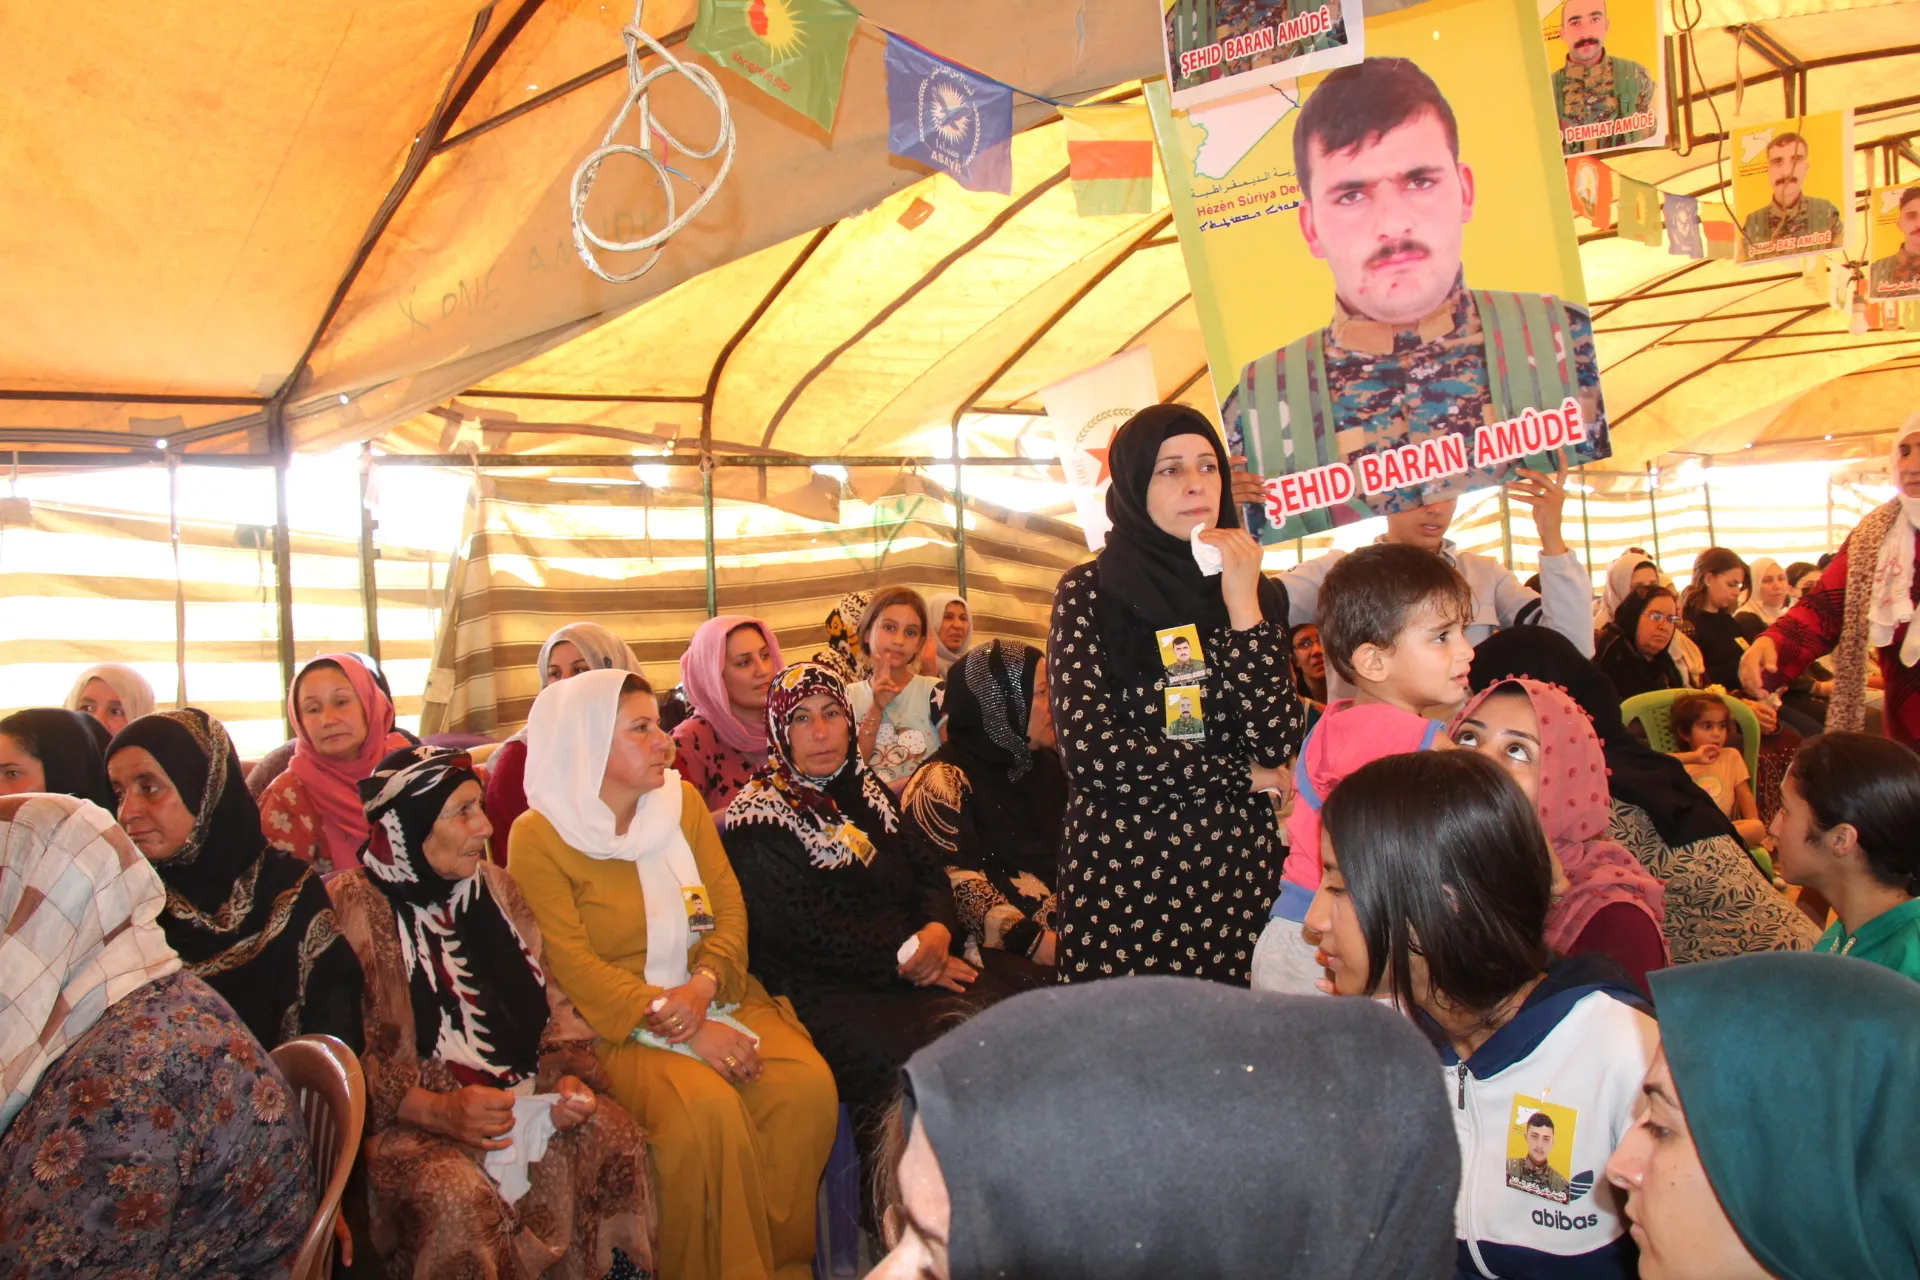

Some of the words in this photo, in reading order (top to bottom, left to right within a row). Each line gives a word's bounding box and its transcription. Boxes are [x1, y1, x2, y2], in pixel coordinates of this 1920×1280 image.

[1181, 44, 1221, 77] ŞEHID
[1226, 29, 1273, 60] BARAN
[1279, 7, 1331, 44] AMÛDÊ
[1566, 122, 1612, 142] DEMHAT
[1615, 111, 1654, 134] AMÛDÊ
[1777, 238, 1796, 250] BAZ
[1266, 466, 1351, 525] ŞEHID
[1363, 437, 1464, 492] BARAN
[1478, 401, 1583, 463] AMÛDÊ
[1532, 1208, 1598, 1231] abibas
